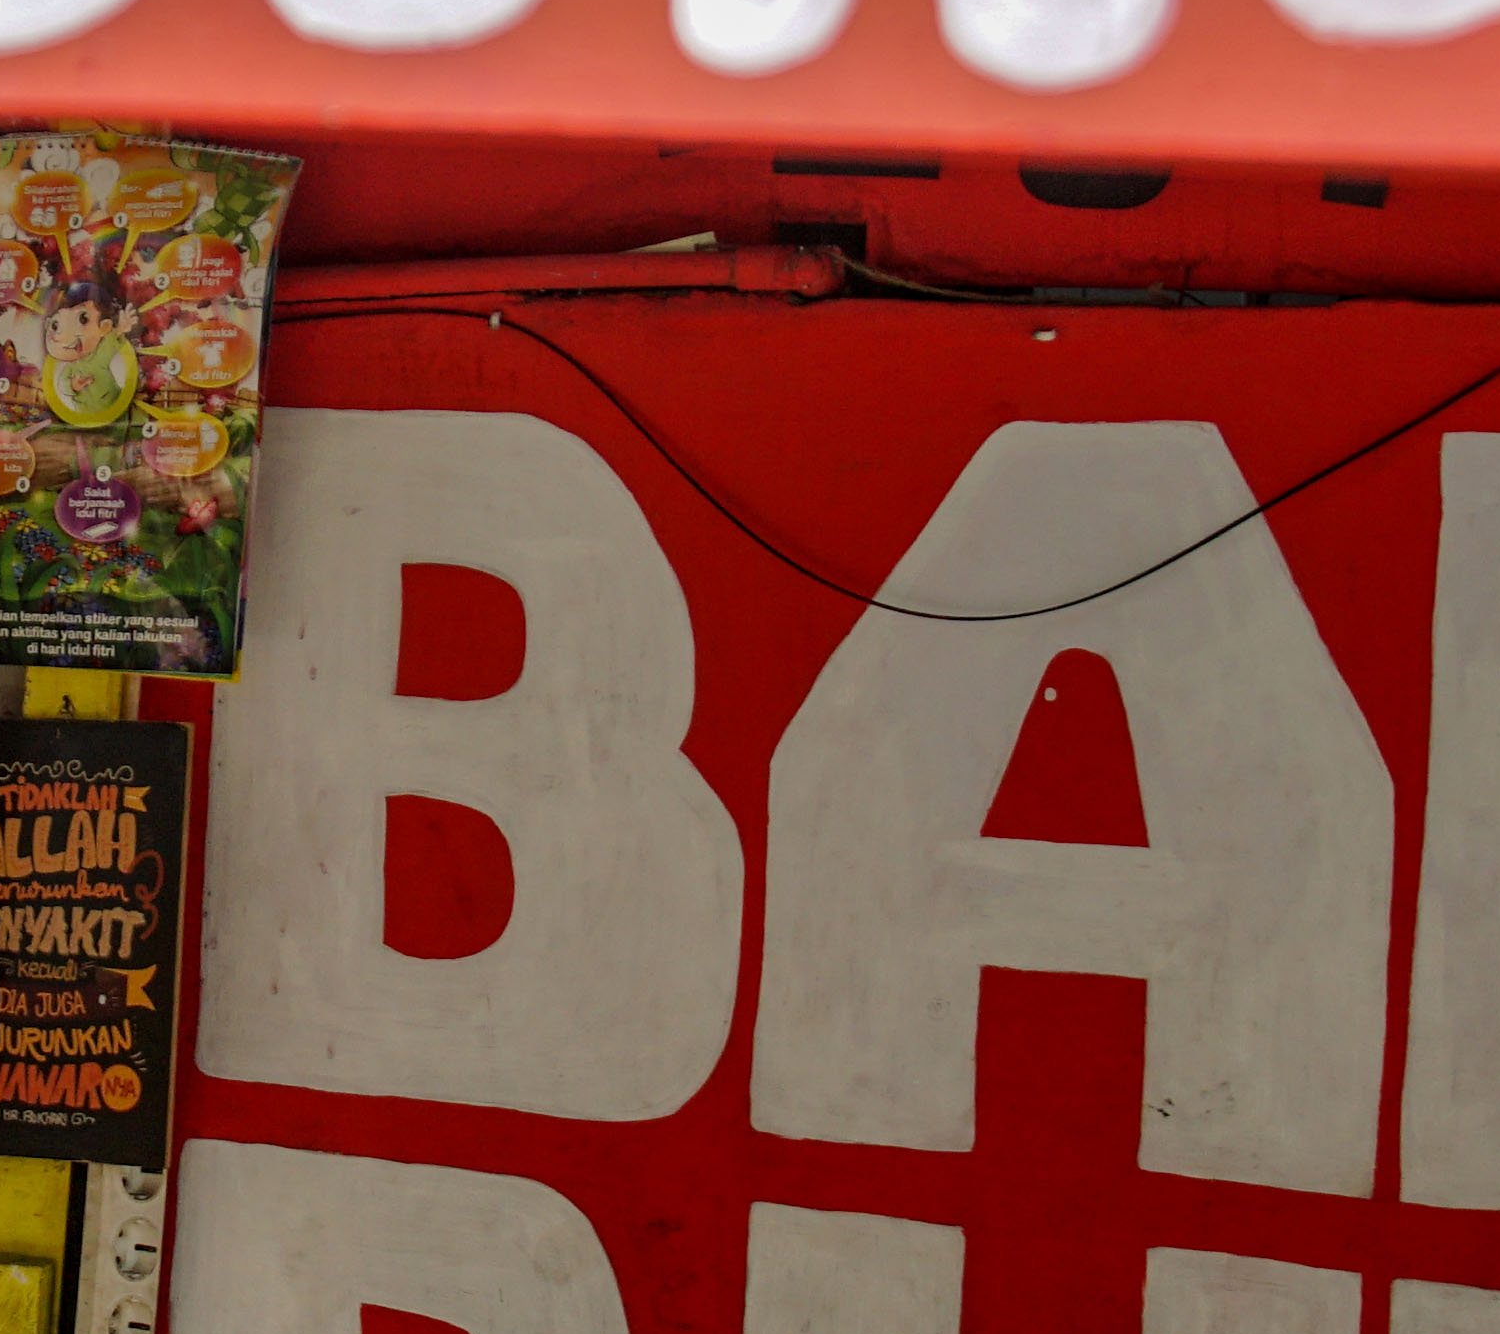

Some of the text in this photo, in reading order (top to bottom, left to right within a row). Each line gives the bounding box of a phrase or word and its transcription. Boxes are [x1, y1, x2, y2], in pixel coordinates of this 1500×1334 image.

[20, 610, 83, 626] tempelkan
[85, 613, 123, 626] stiker
[124, 615, 154, 630] yang
[156, 615, 199, 629] sesuai
[11, 626, 58, 640] aktifitas
[60, 629, 92, 643] yang
[94, 629, 132, 641] kalian
[133, 629, 183, 643] lakukan
[27, 642, 116, 658] di hari idul fitri
[17, 958, 78, 982] kecuali
[35, 989, 87, 1018] JUGA
